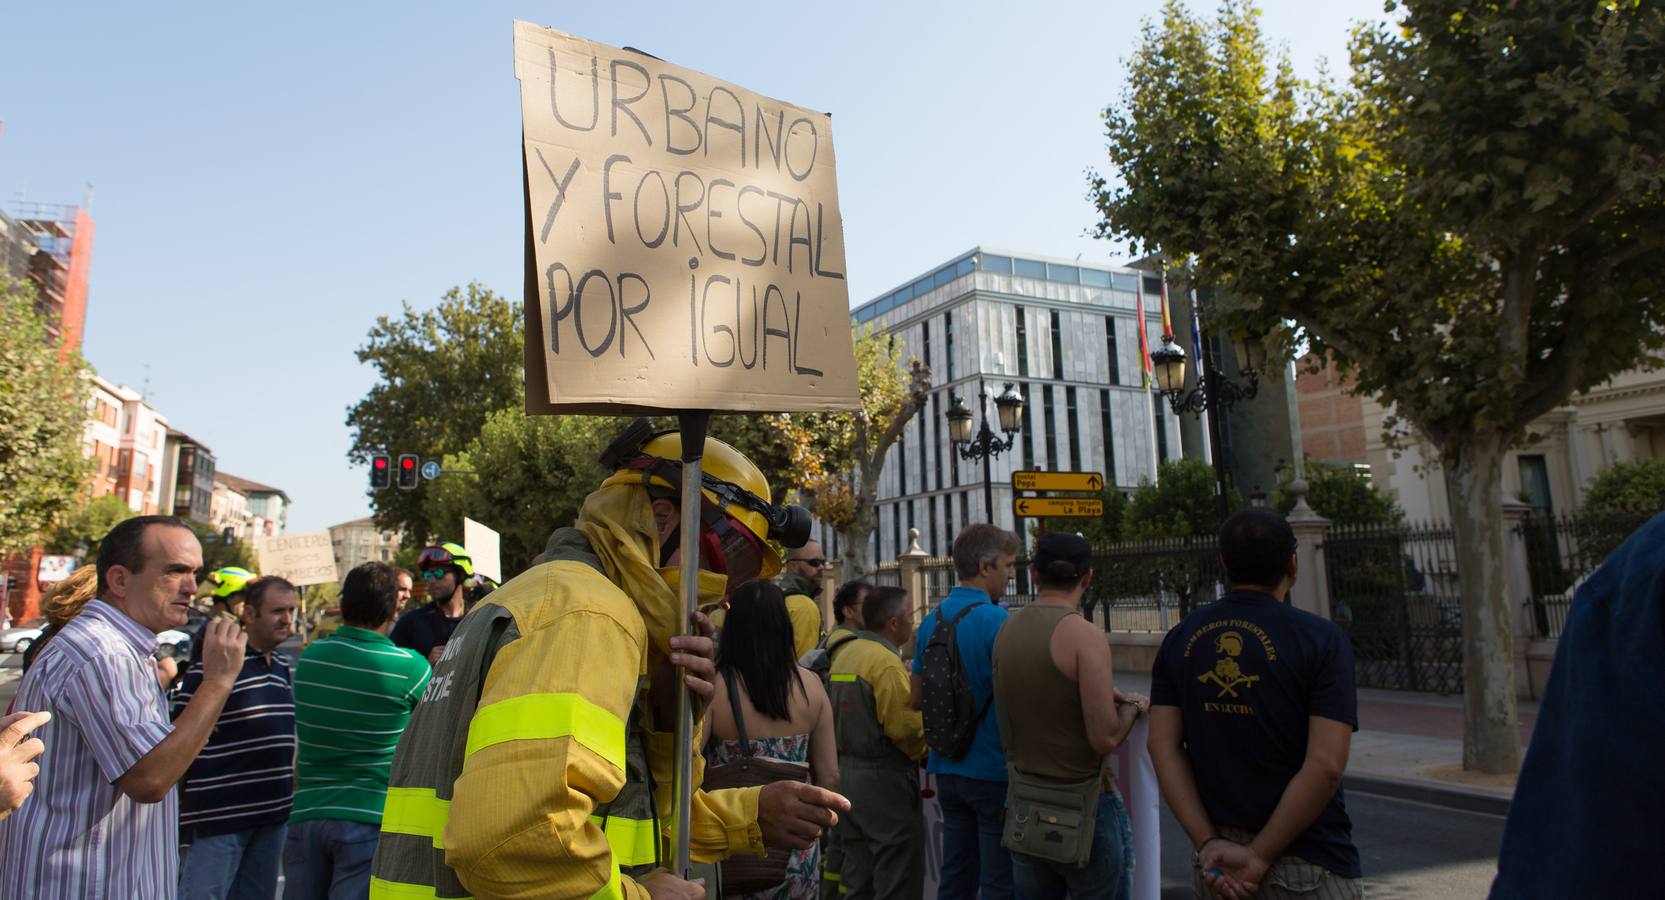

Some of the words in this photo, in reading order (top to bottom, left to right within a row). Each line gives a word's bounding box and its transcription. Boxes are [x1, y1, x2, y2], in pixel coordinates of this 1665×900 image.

[548, 46, 818, 182] URBANO
[535, 147, 581, 244] Y
[603, 153, 845, 280] FORESTAL
[546, 262, 655, 361] POR
[1016, 480, 1036, 488] Pepa
[1063, 506, 1073, 514] La
[1078, 506, 1101, 515] Playa
[1184, 620, 1228, 657] BOMBEROS
[1229, 620, 1277, 661] FORESTALES
[1204, 702, 1219, 712] EN
